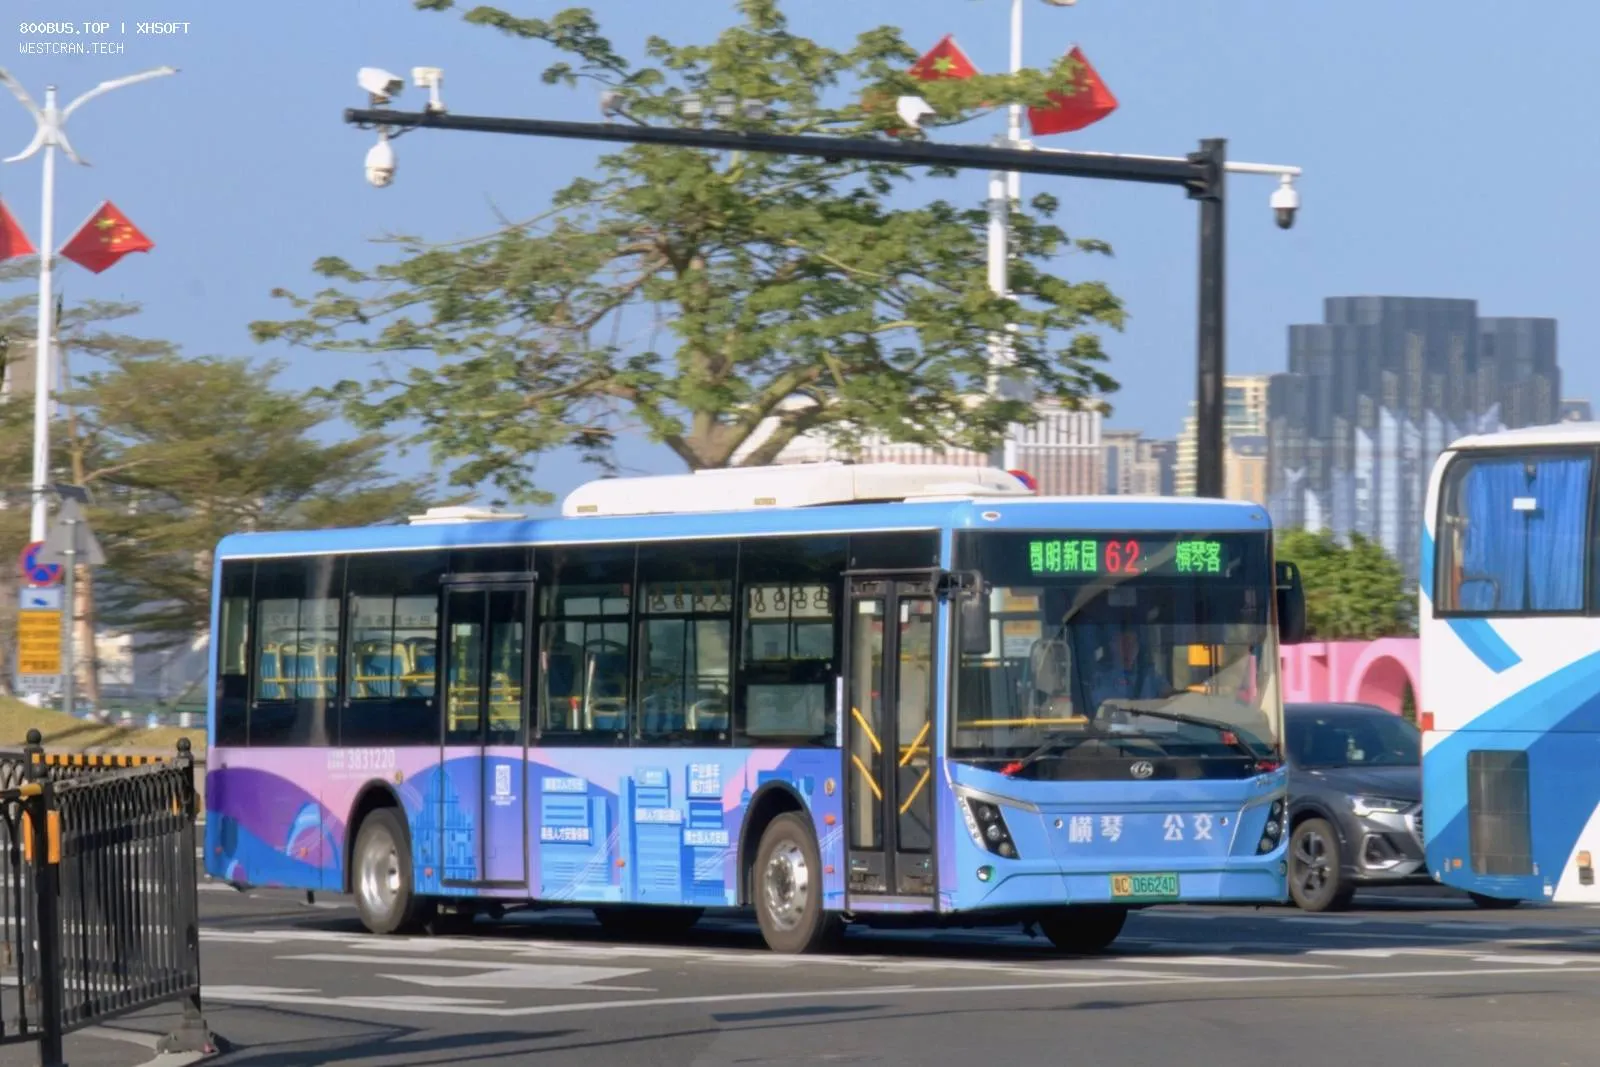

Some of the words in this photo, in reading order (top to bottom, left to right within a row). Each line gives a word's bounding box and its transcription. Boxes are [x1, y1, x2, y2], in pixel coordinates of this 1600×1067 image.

[1105, 540, 1140, 573] 62
[1175, 541, 1221, 573] 横琴客
[347, 748, 396, 769] 3831220
[1068, 814, 1124, 844] 横琴
[1163, 813, 1214, 841] 公交
